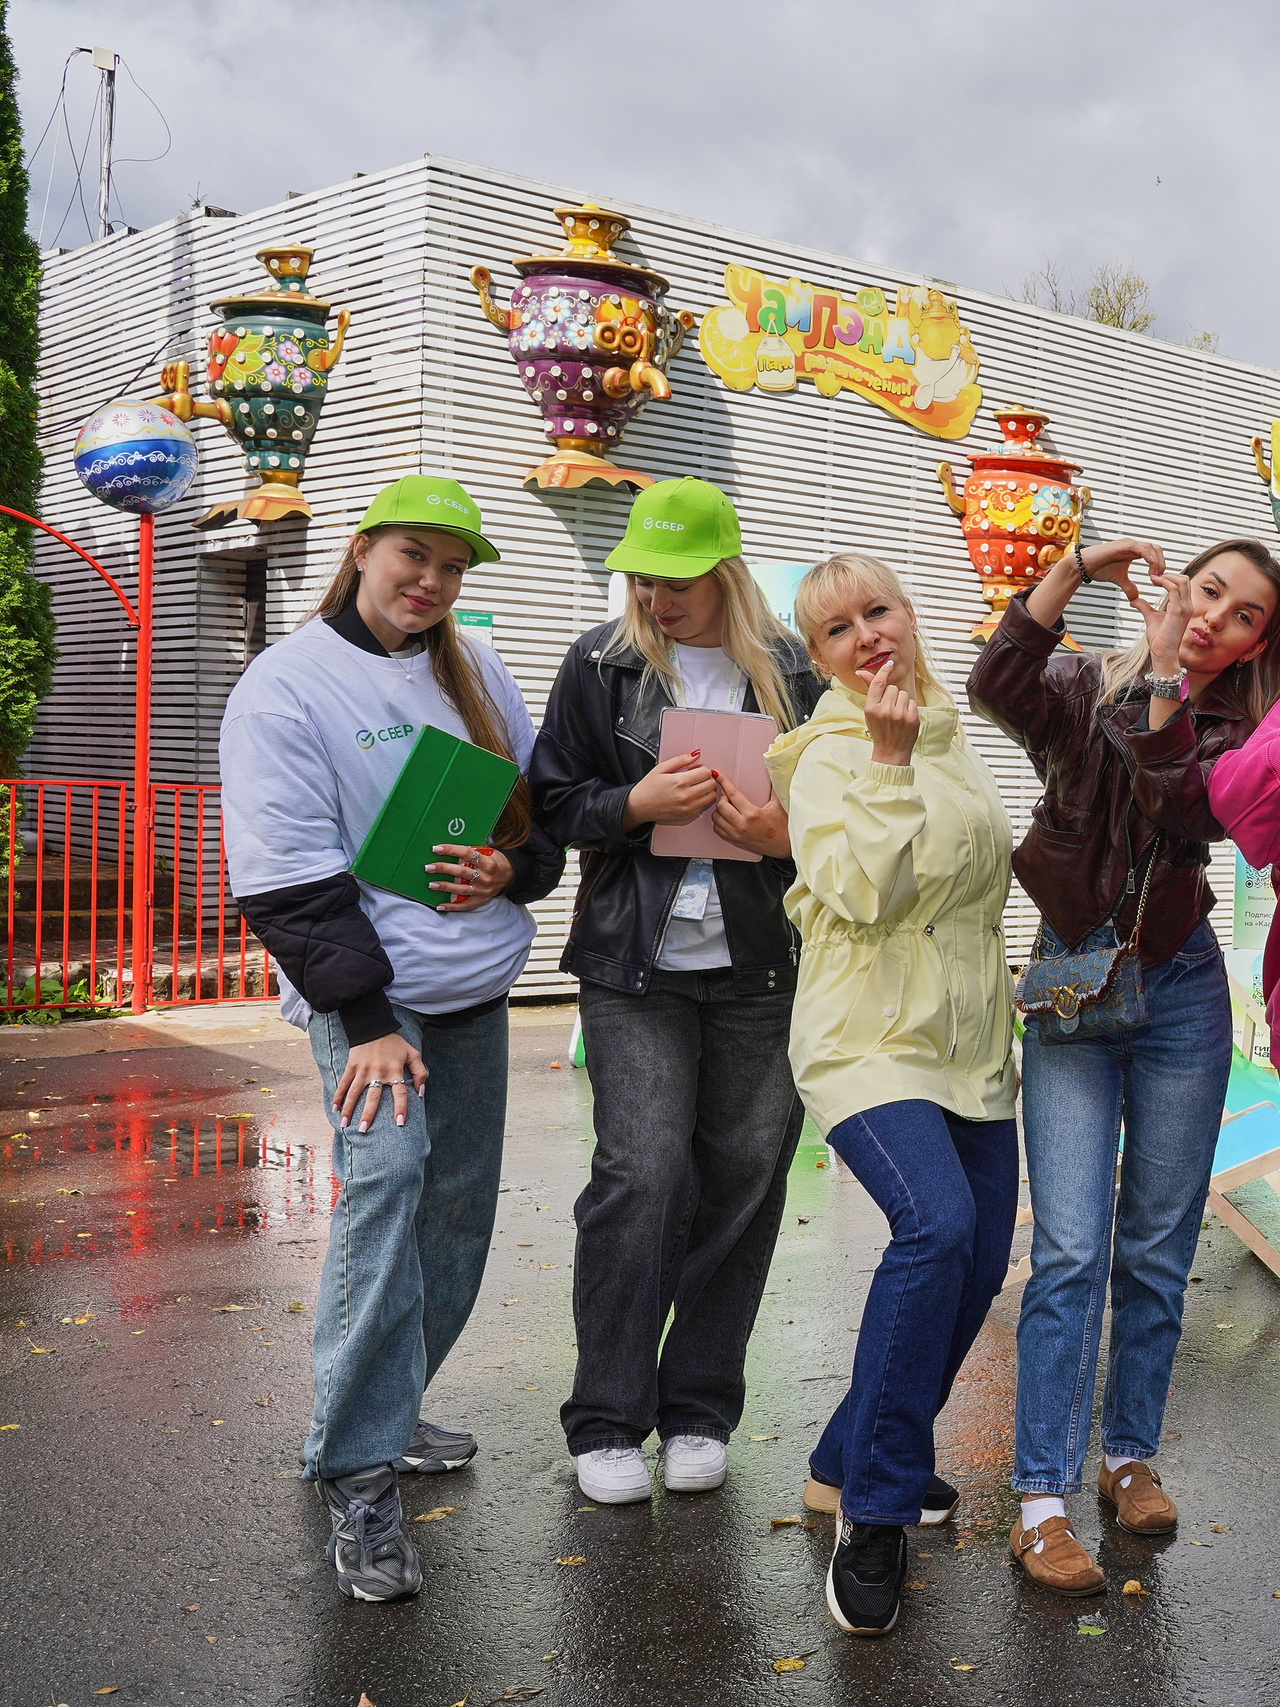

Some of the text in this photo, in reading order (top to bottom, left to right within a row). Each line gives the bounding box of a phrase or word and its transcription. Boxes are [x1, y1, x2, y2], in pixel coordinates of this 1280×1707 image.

[443, 498, 469, 515] СБЕР
[655, 520, 685, 532] СБЕР
[377, 724, 414, 742] СБЕР
[1245, 911, 1273, 919] Подпис
[1255, 920, 1271, 928] «Кар
